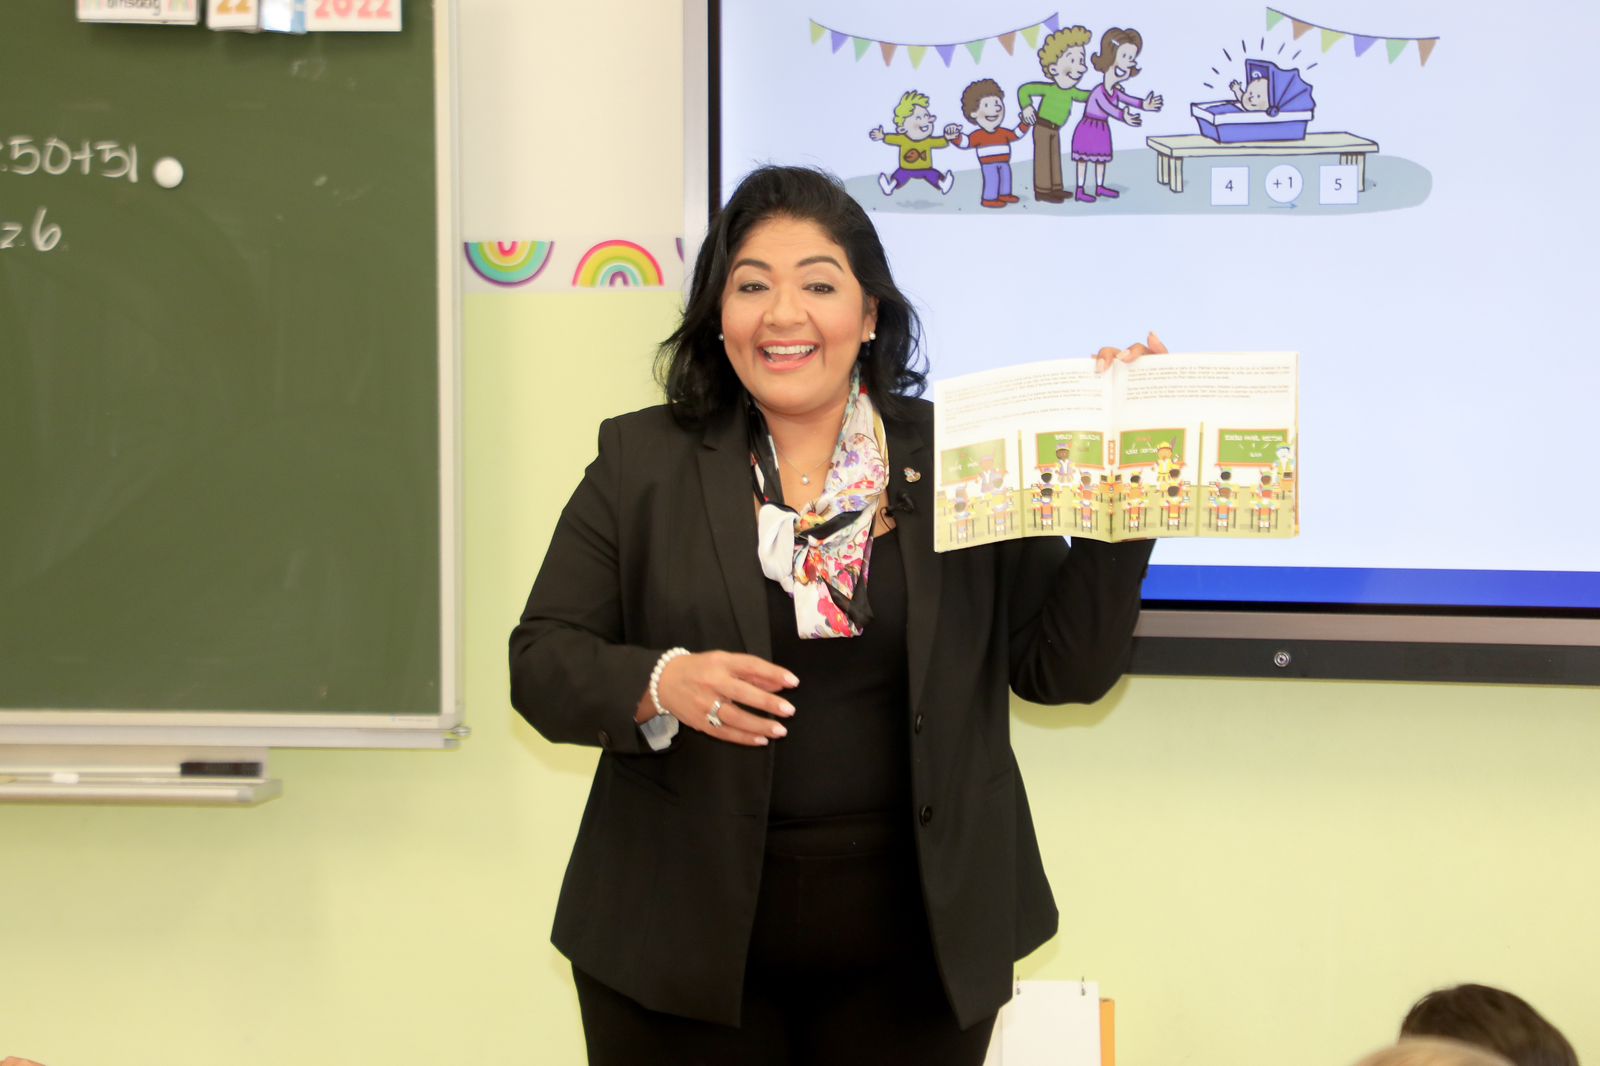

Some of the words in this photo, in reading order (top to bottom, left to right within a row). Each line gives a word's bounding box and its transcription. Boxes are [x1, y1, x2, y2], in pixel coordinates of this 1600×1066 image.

[315, 0, 392, 19] 2022
[1224, 179, 1234, 192] 4
[1334, 178, 1342, 191] 5
[32, 205, 62, 251] 6
